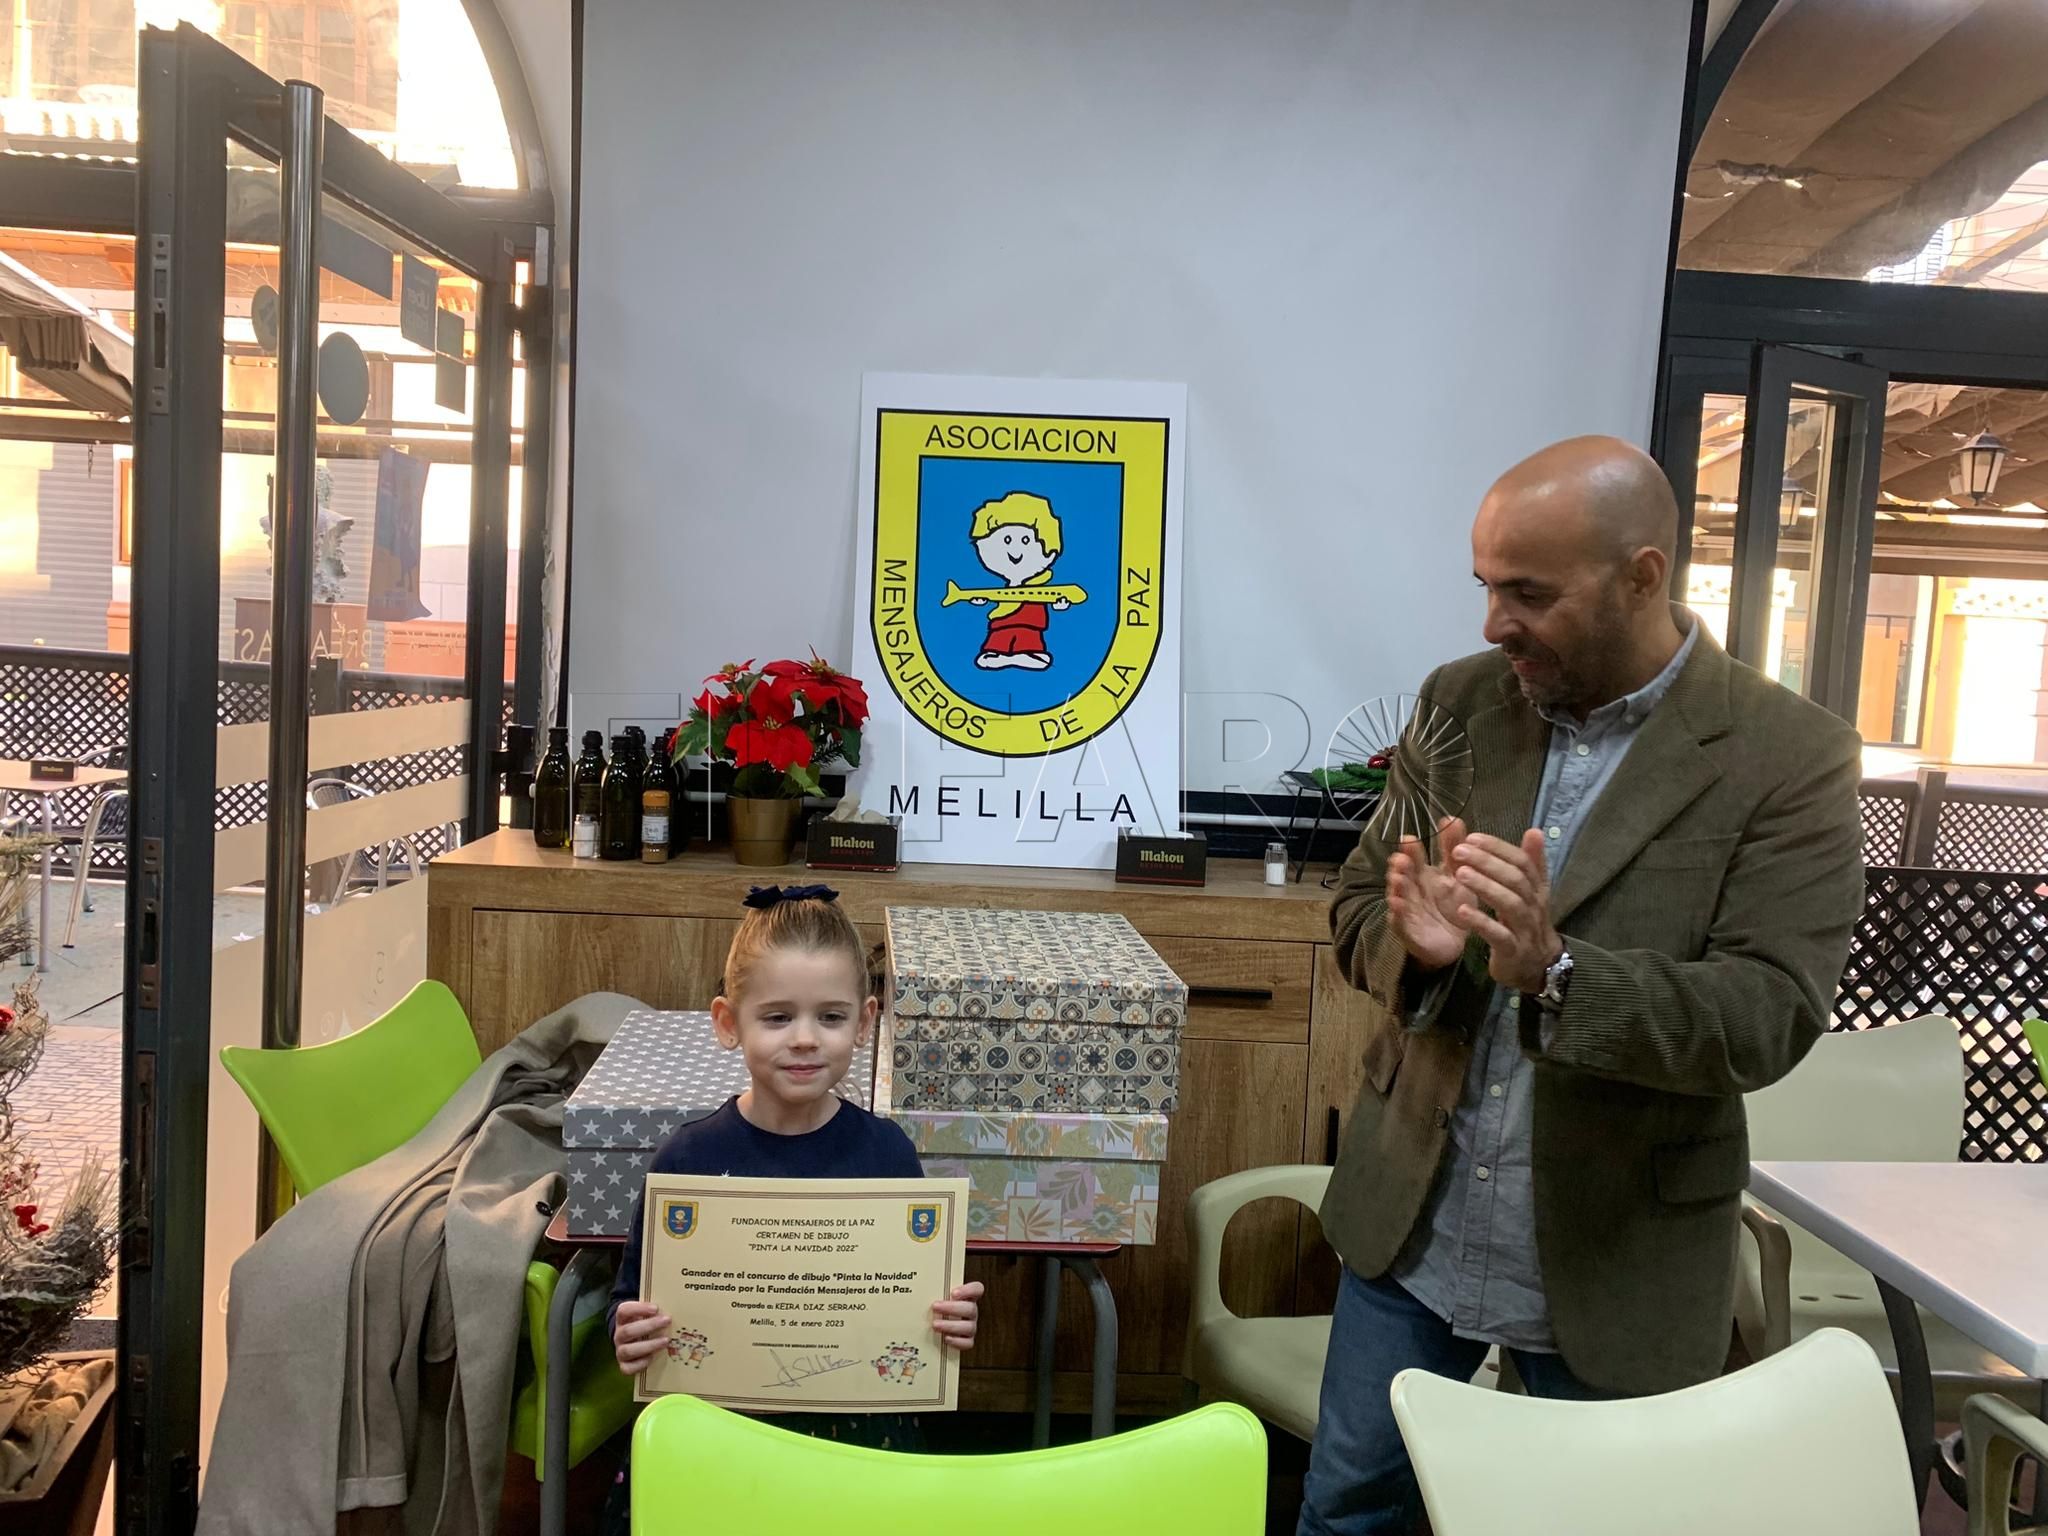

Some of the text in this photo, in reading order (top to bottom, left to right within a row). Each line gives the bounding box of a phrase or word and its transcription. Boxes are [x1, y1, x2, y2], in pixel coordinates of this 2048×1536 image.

[924, 424, 1117, 455] ASOCIACION
[881, 558, 1151, 743] MENSAJEROS DE LA PAZ
[889, 784, 1138, 824] MELILLA
[830, 836, 875, 849] Mahou
[1140, 850, 1185, 864] Mahou
[731, 1217, 780, 1226] FUNDACION
[782, 1218, 835, 1227] MENSAJEROS
[860, 1218, 875, 1226] PAZ
[756, 1231, 801, 1239] CERTAMEN
[748, 1243, 778, 1251] "PINTA
[781, 1244, 791, 1252] LA
[794, 1244, 834, 1252] NAVIDAD
[681, 1268, 721, 1278] Ganador
[736, 1271, 745, 1279] el
[747, 1273, 786, 1281] concurso
[788, 1272, 799, 1281] de
[801, 1272, 831, 1282] dibujo
[863, 1272, 872, 1281] la
[684, 1283, 913, 1295] organizado por la Fundación Mensajeros de la Paz.
[731, 1301, 765, 1310] Otorgado
[775, 1302, 800, 1310] KEIRA
[803, 1303, 825, 1311] DIAZ
[780, 1319, 786, 1327] 5
[788, 1319, 798, 1327] de
